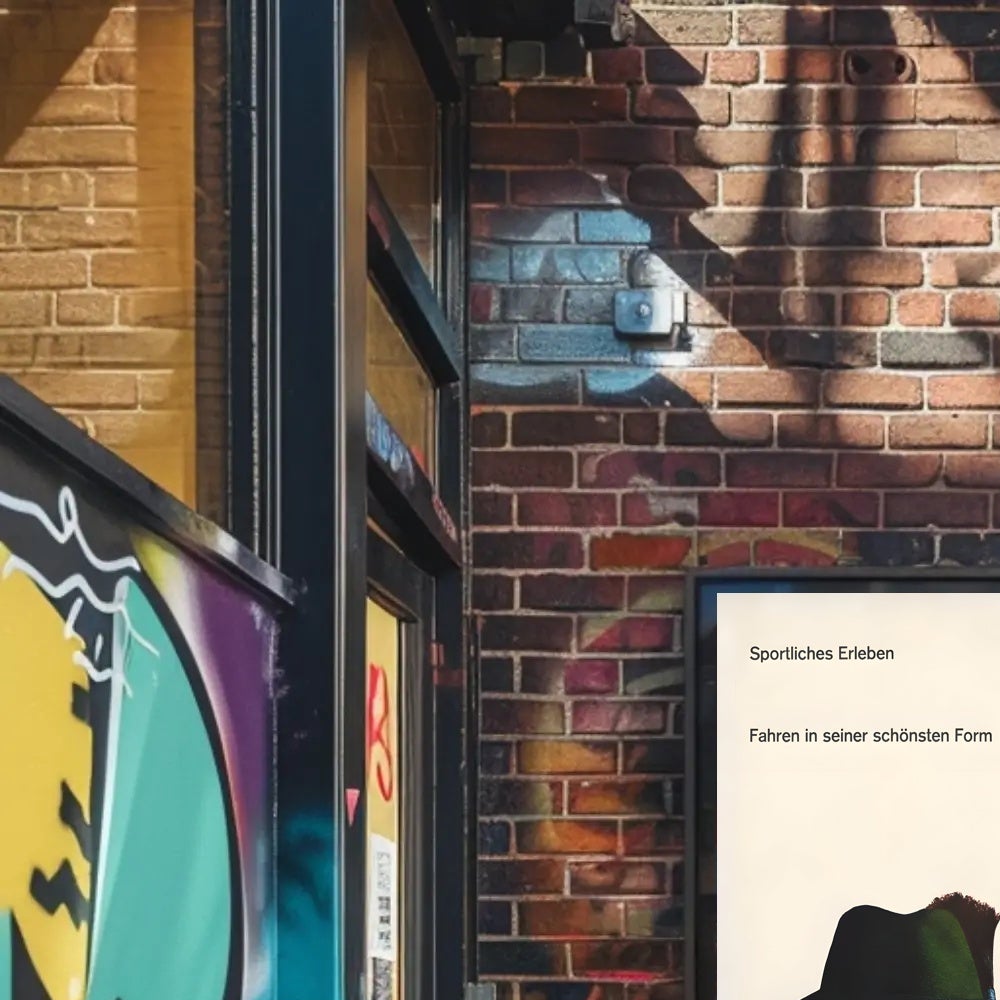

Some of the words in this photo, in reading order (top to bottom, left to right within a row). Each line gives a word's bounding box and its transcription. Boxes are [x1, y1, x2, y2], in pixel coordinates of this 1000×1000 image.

[749, 645, 834, 662] Sportliches
[838, 645, 895, 660] Erleben
[749, 728, 800, 742] Fahren
[805, 728, 818, 742] in
[822, 728, 868, 742] seiner
[873, 728, 950, 742] schönsten
[954, 728, 993, 742] Form
